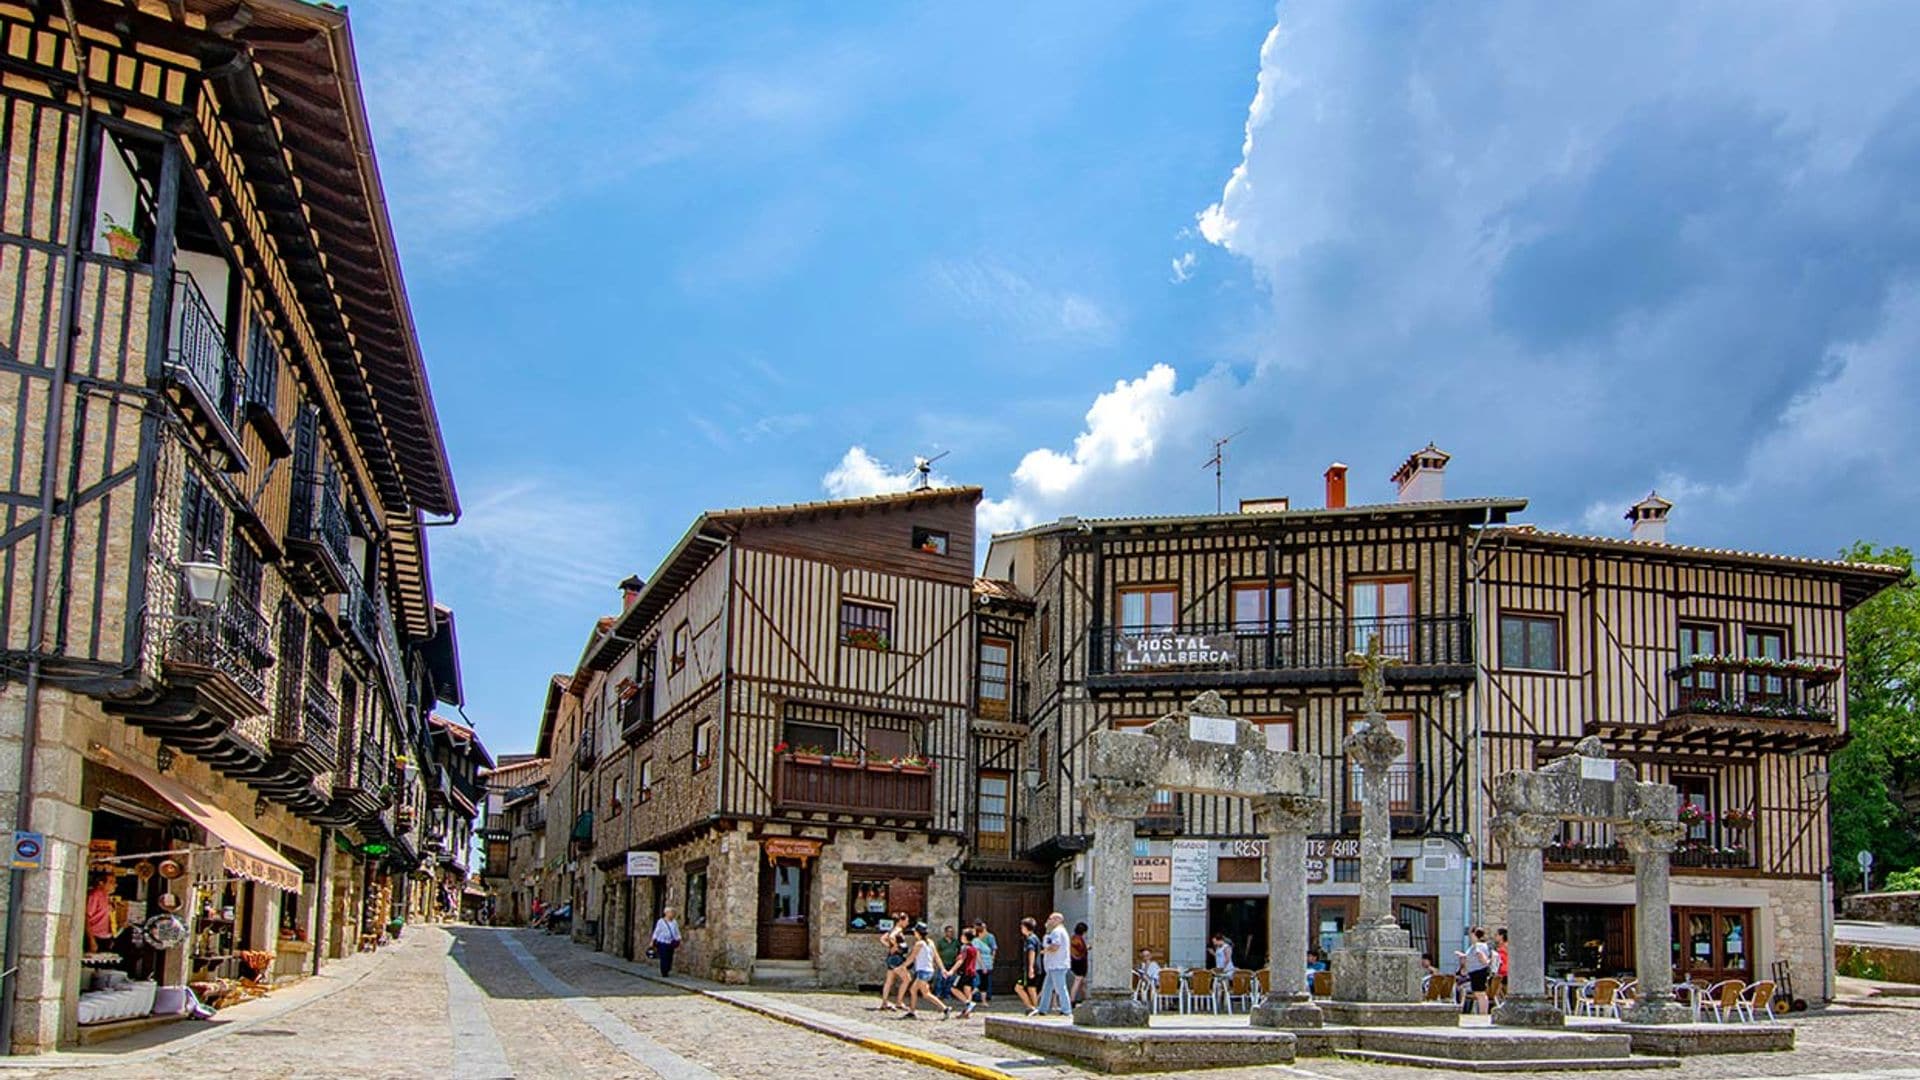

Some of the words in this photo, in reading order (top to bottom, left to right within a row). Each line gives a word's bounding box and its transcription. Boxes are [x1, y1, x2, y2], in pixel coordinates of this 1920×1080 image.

[1137, 638, 1211, 651] HOSTAL
[1127, 650, 1152, 664] LA
[1157, 650, 1230, 663] ALBERCA
[1332, 840, 1361, 857] BAR
